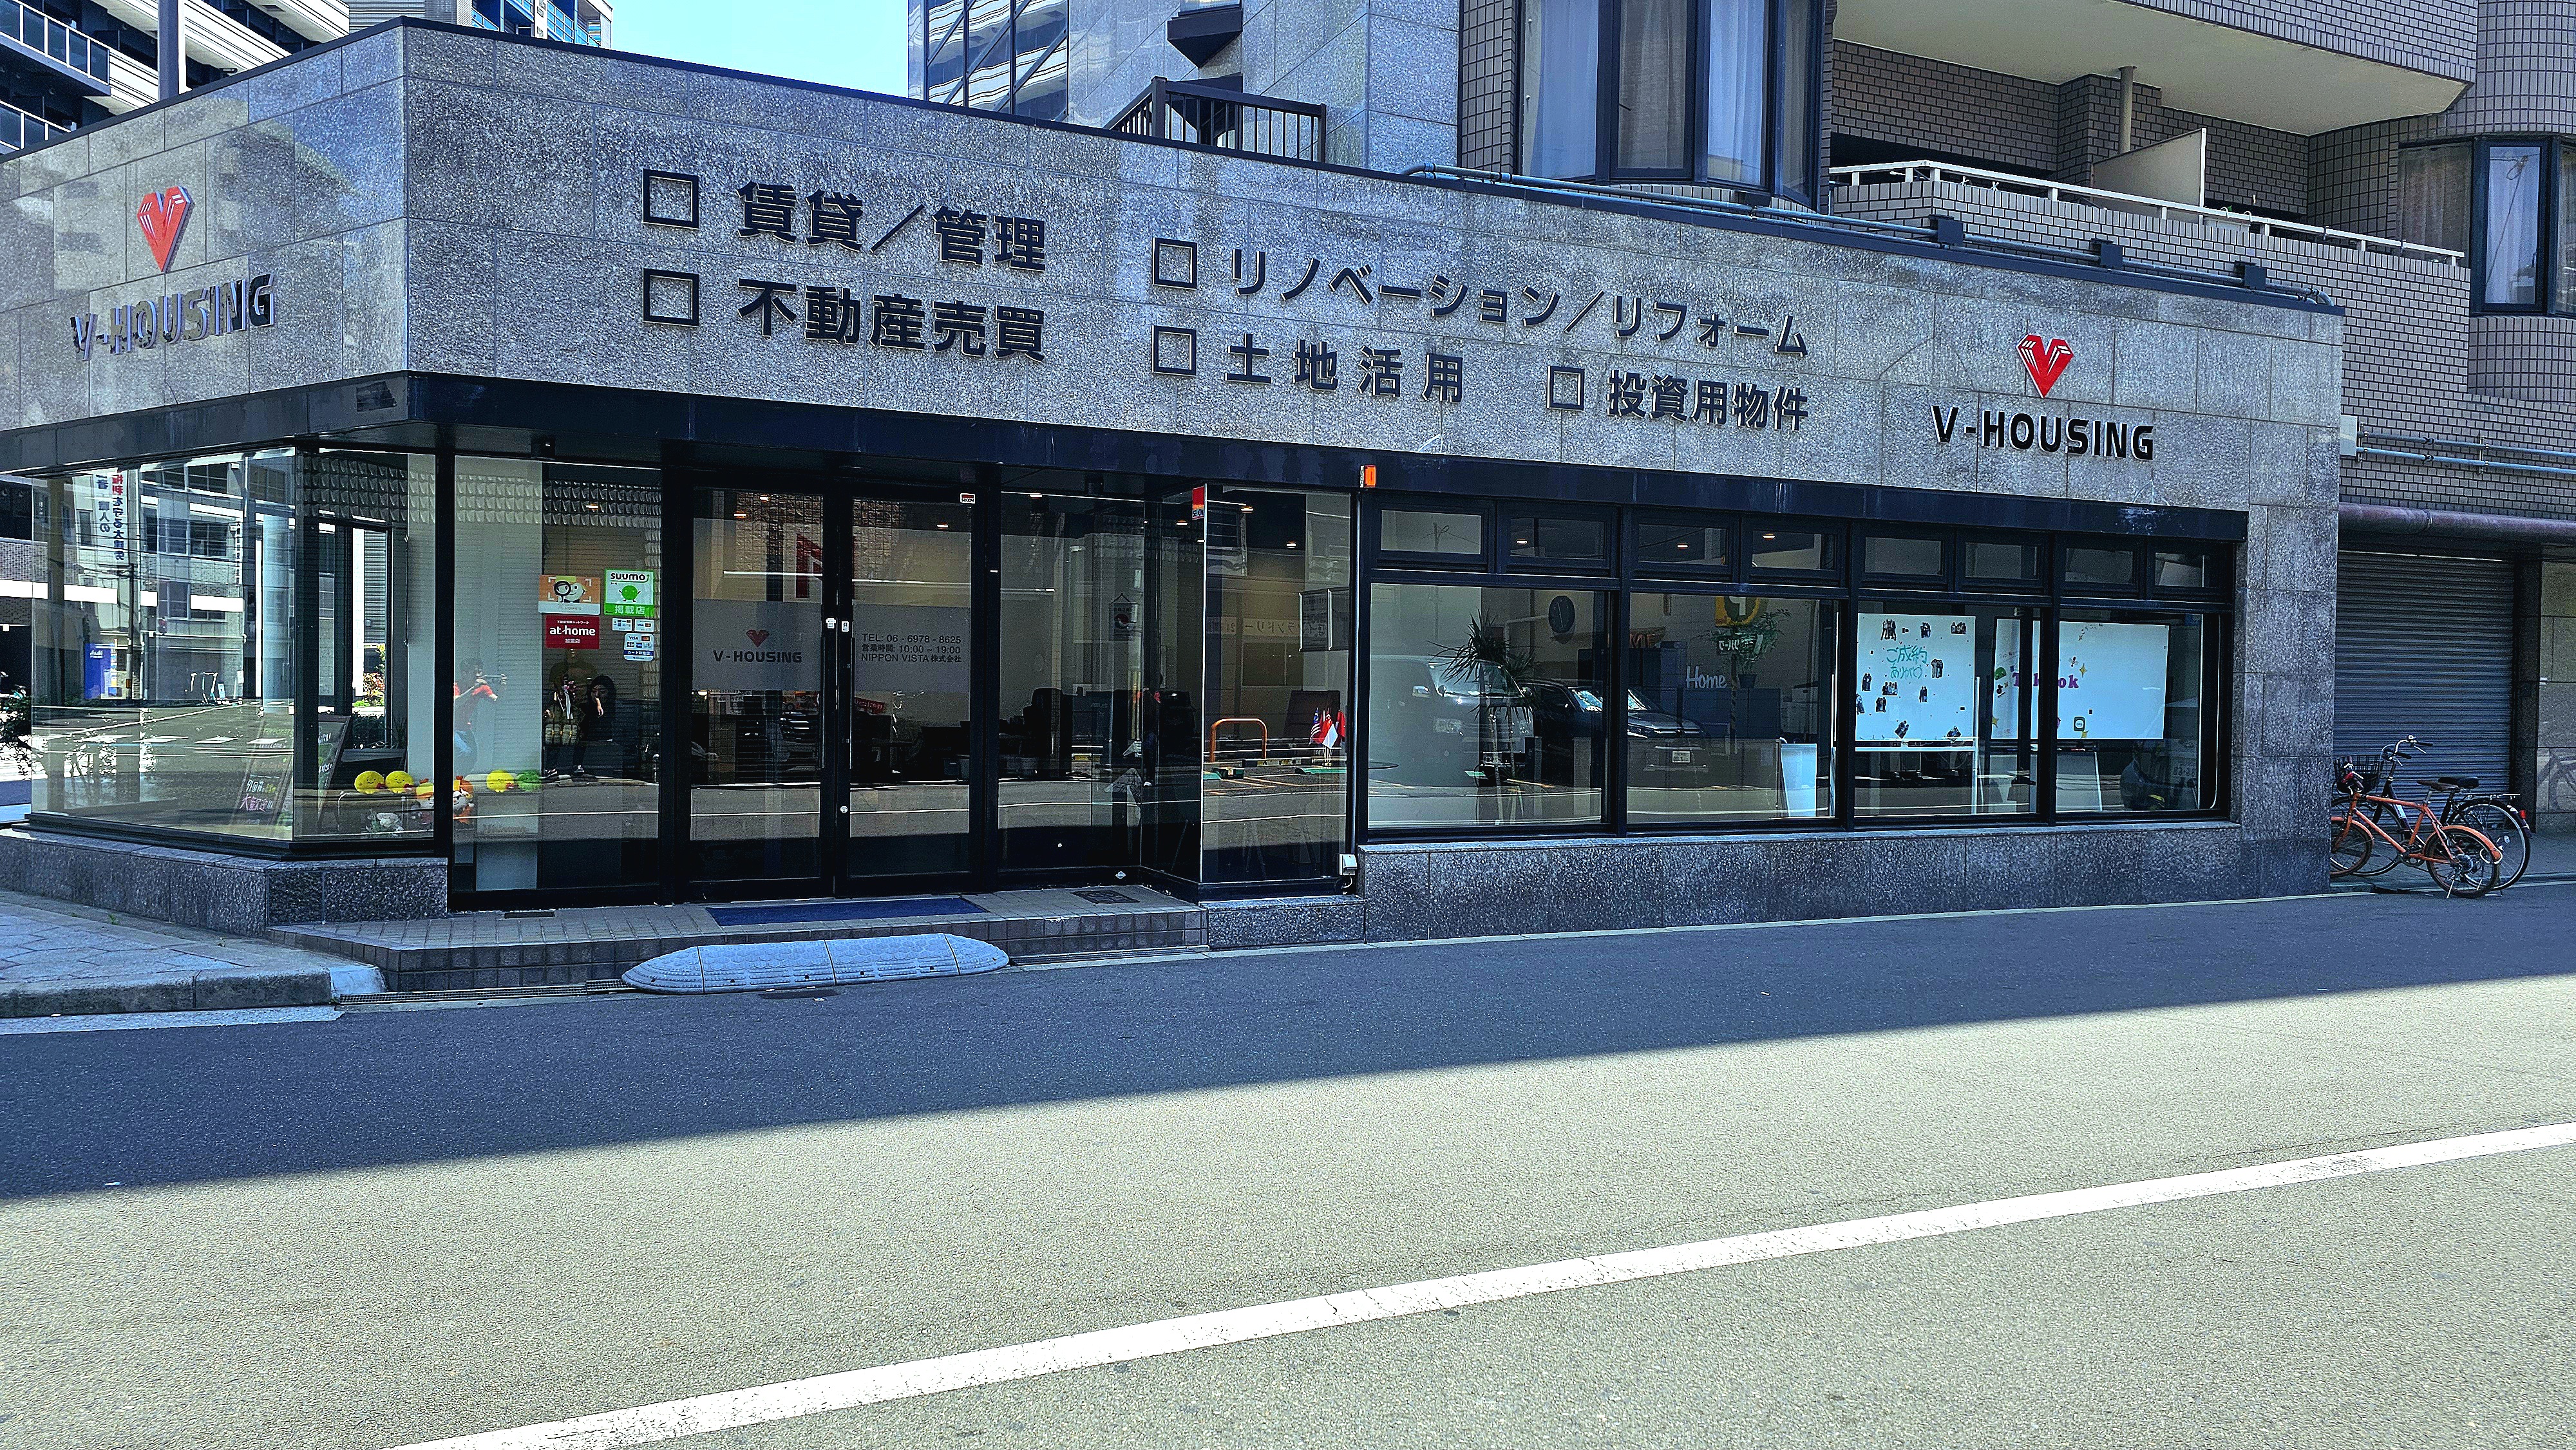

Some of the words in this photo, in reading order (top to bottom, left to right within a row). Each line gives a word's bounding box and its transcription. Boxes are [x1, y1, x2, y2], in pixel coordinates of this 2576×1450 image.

[70, 273, 275, 362] V-HOUSING
[737, 278, 1045, 362] 不動産売買
[1225, 334, 1463, 402] 土地活用
[1607, 370, 1809, 431] 投資用物件
[1931, 405, 2154, 460] V-HOUSING
[614, 605, 645, 614] 掲載店
[862, 633, 884, 643] TEL:
[907, 635, 930, 643] 6978
[938, 636, 961, 644] 8625
[936, 646, 961, 654] 19:00
[861, 654, 898, 663] NIPPON
[902, 654, 929, 663] VISTA
[931, 654, 962, 663] 株式会社
[1886, 645, 1927, 664] ご成約
[1685, 665, 1727, 689] Home
